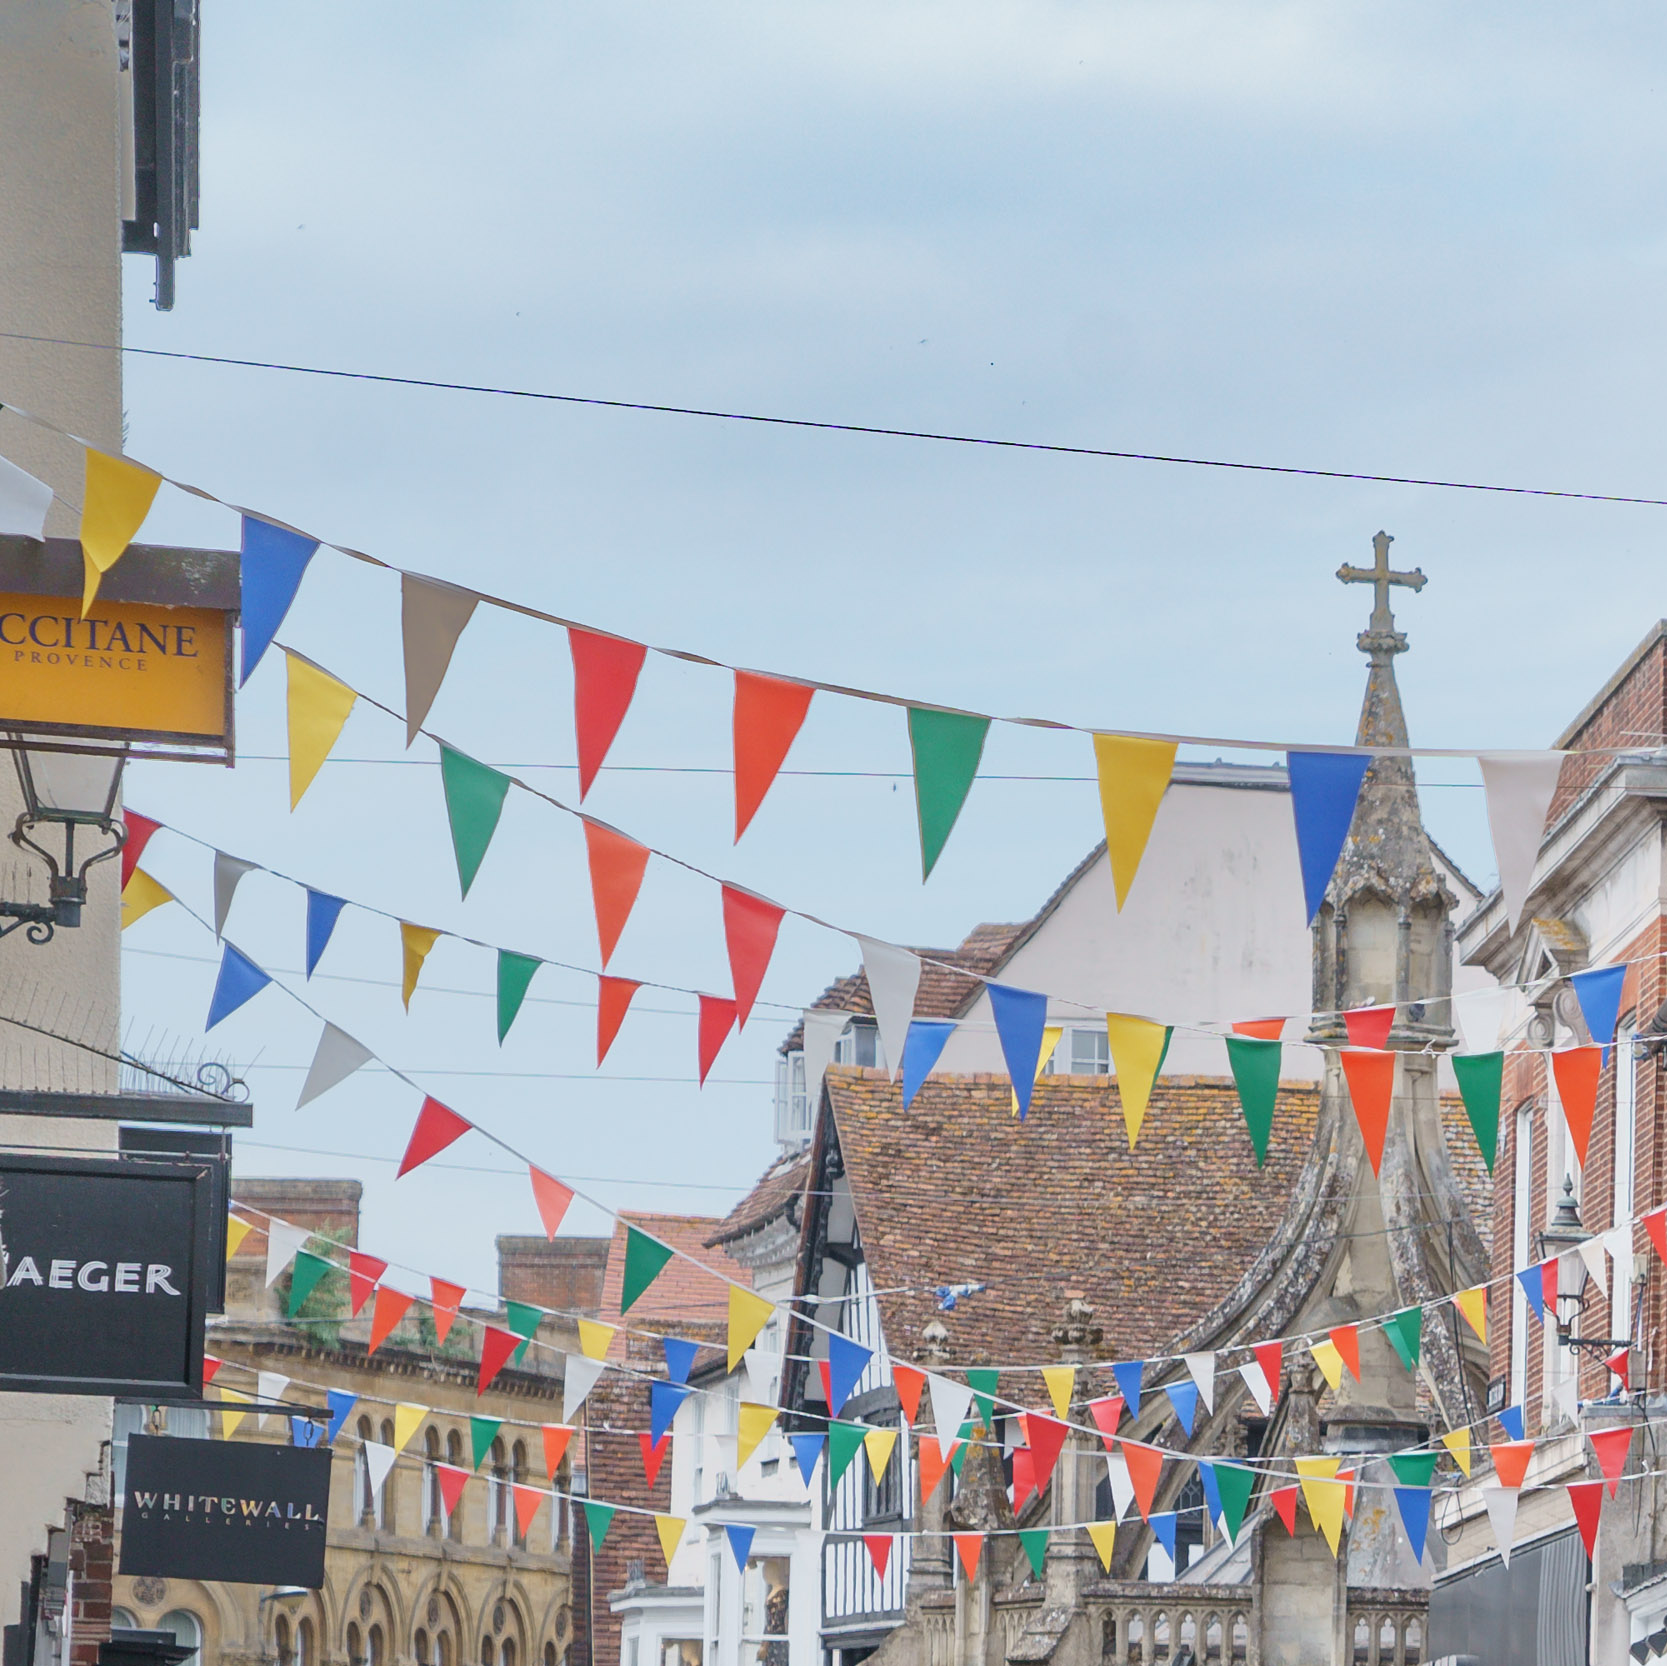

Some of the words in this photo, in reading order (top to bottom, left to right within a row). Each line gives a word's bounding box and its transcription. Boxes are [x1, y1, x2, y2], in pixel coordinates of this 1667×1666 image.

[14, 650, 148, 671] PROVENCE
[134, 1491, 320, 1521] WHITEWALL
[141, 1511, 311, 1531] GALLERIES
